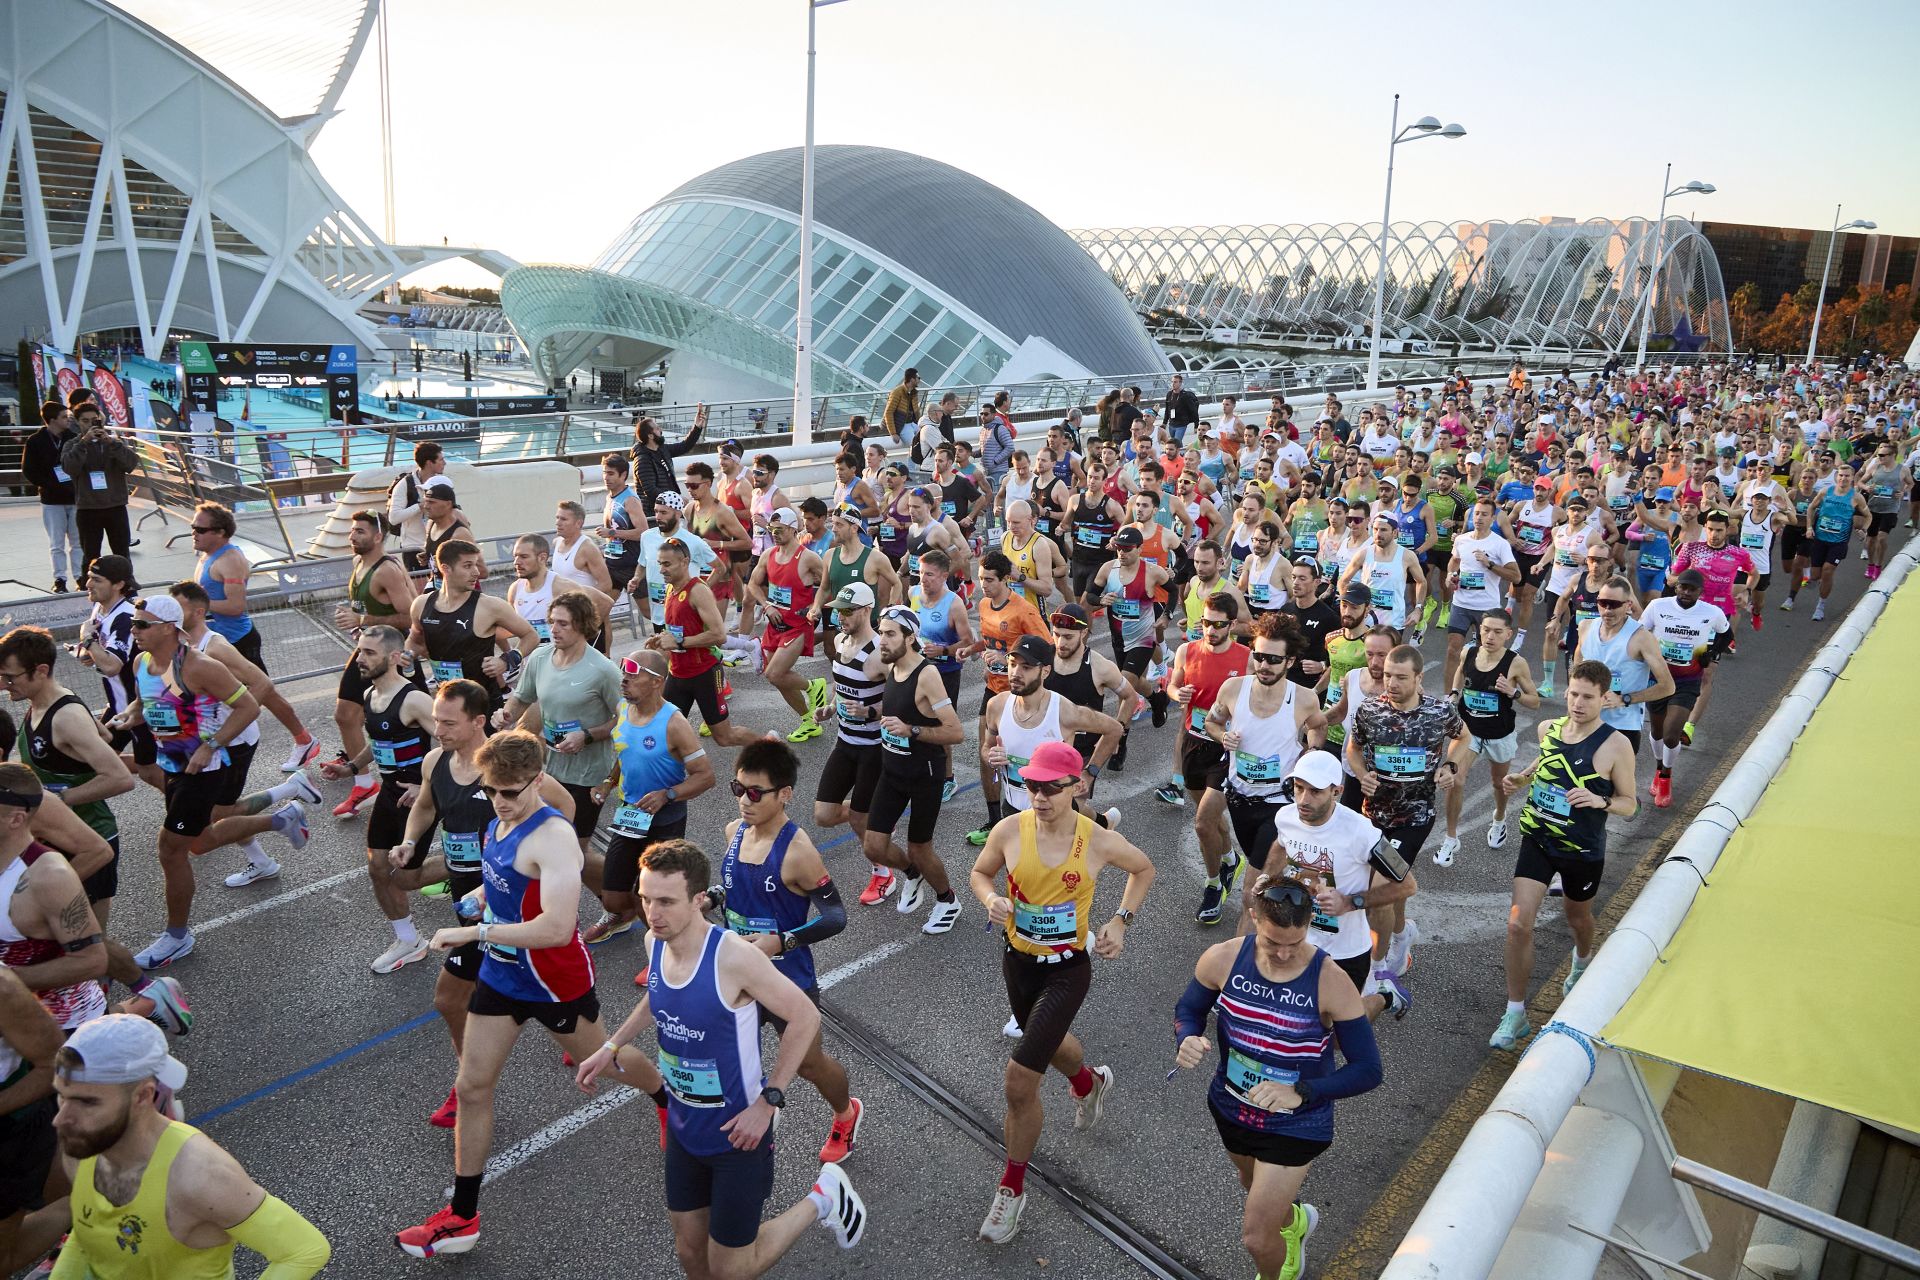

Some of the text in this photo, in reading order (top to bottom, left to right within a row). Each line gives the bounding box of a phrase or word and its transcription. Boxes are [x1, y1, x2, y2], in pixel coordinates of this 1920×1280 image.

[1664, 626, 1700, 637] MARATHON
[1245, 763, 1267, 771] 33299
[623, 810, 639, 819] 4597
[725, 826, 746, 873] FLIPBELT
[1031, 915, 1056, 925] 3308
[1029, 925, 1059, 934] Richard
[670, 1067, 695, 1082] 3580
[675, 1081, 693, 1093] Tom
